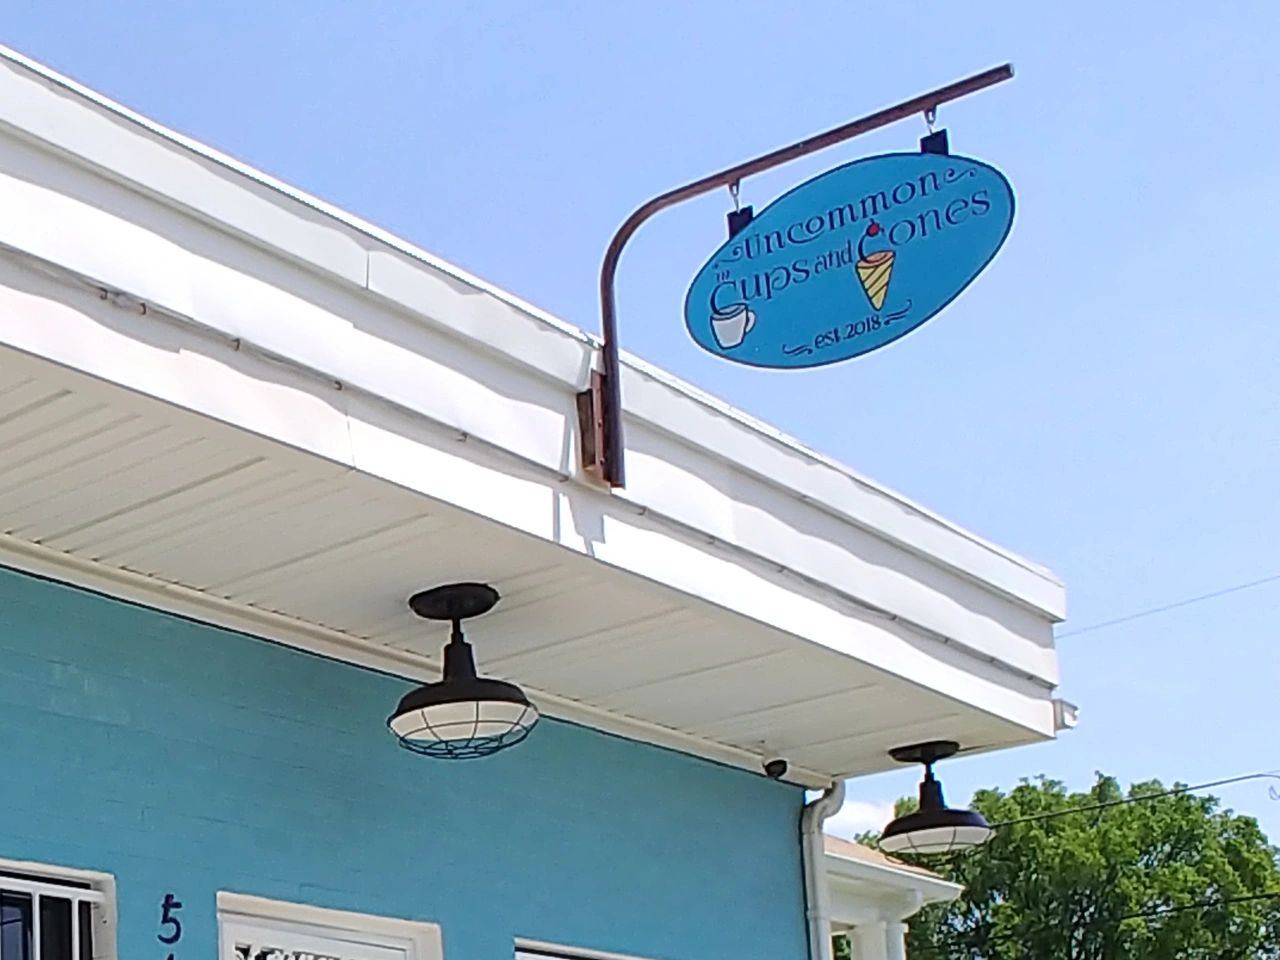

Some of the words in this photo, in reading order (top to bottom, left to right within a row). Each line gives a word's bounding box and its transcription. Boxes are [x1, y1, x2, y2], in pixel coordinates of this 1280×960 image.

[710, 258, 810, 316] Cups
[814, 239, 853, 275] and
[858, 189, 991, 264] Cones
[725, 171, 940, 263] Uncommon
